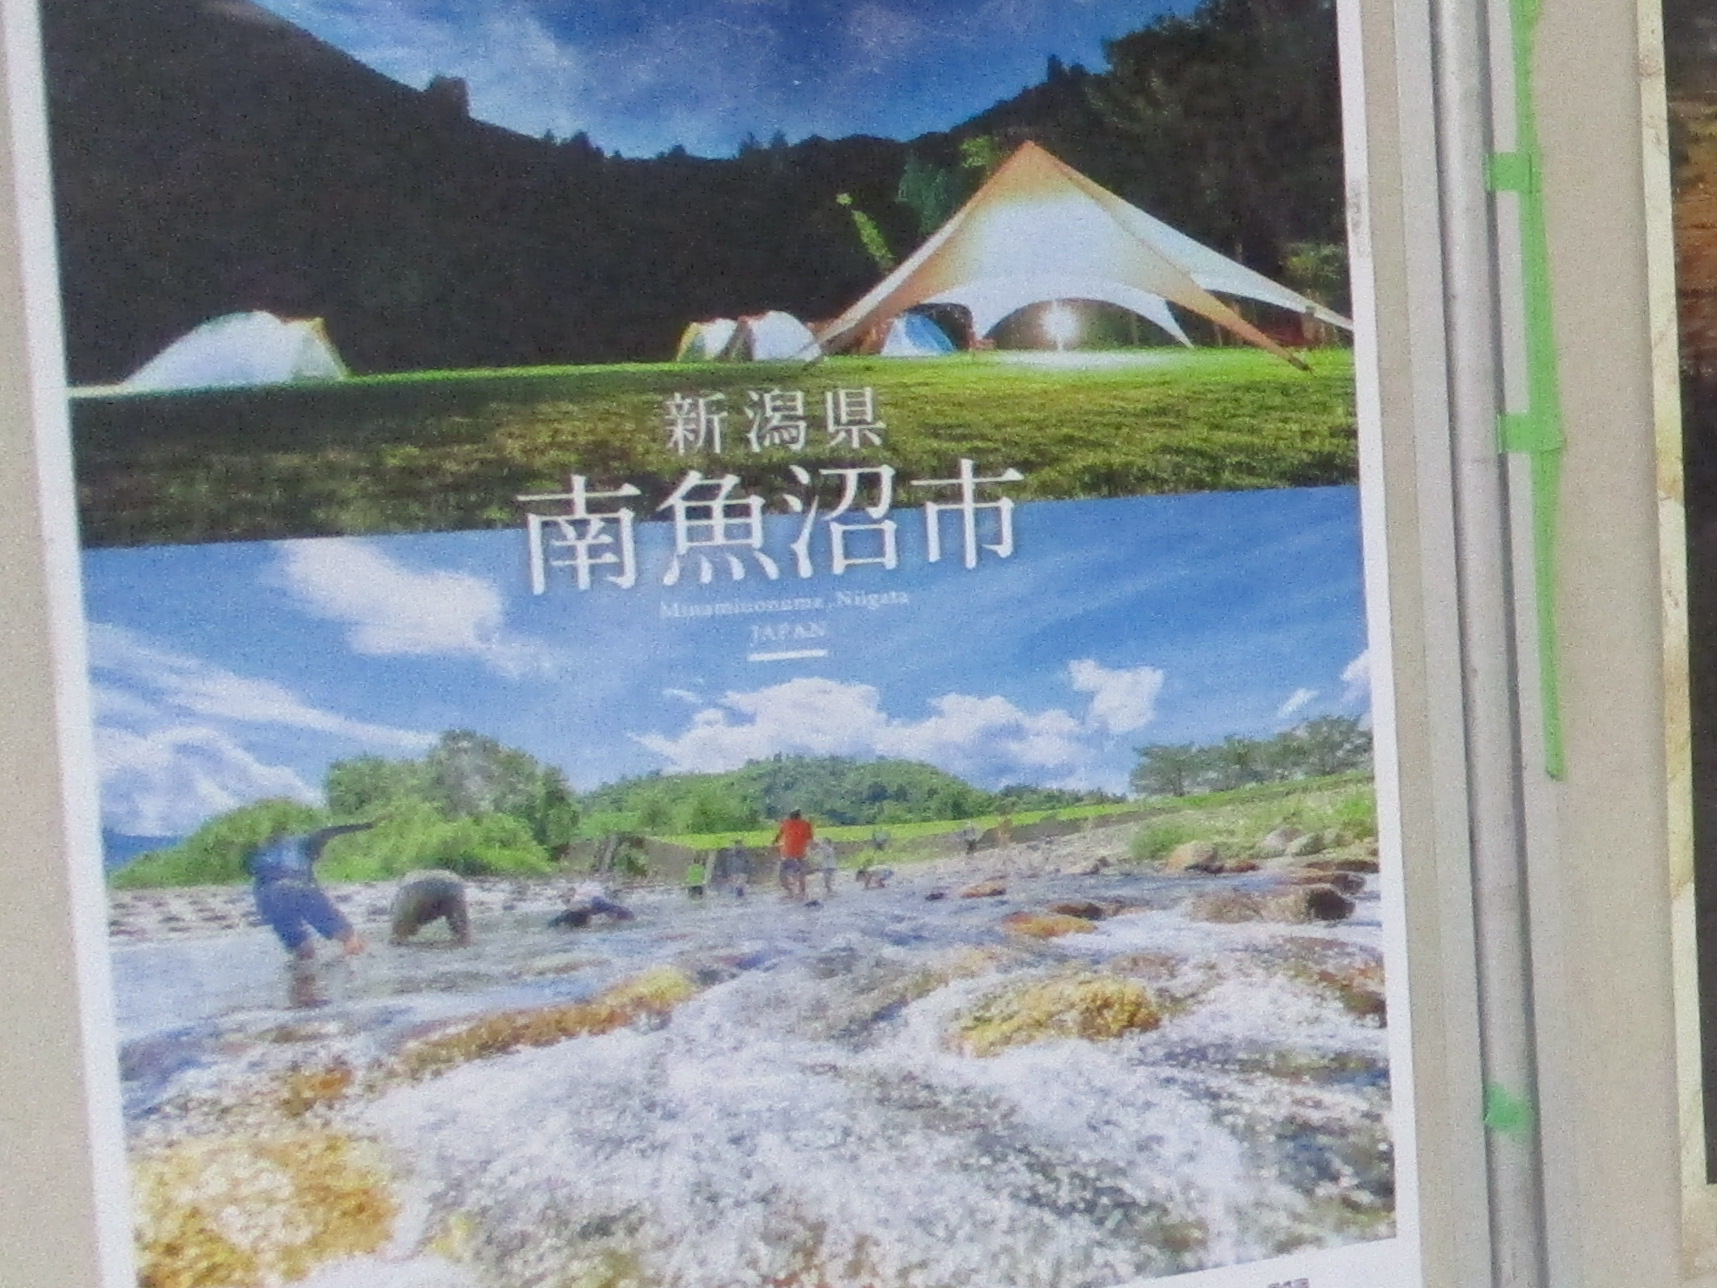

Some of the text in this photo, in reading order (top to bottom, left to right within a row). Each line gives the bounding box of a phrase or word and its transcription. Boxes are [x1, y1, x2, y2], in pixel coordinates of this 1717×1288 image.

[664, 386, 888, 455] 新潟県
[513, 460, 1025, 596] 南魚沼市
